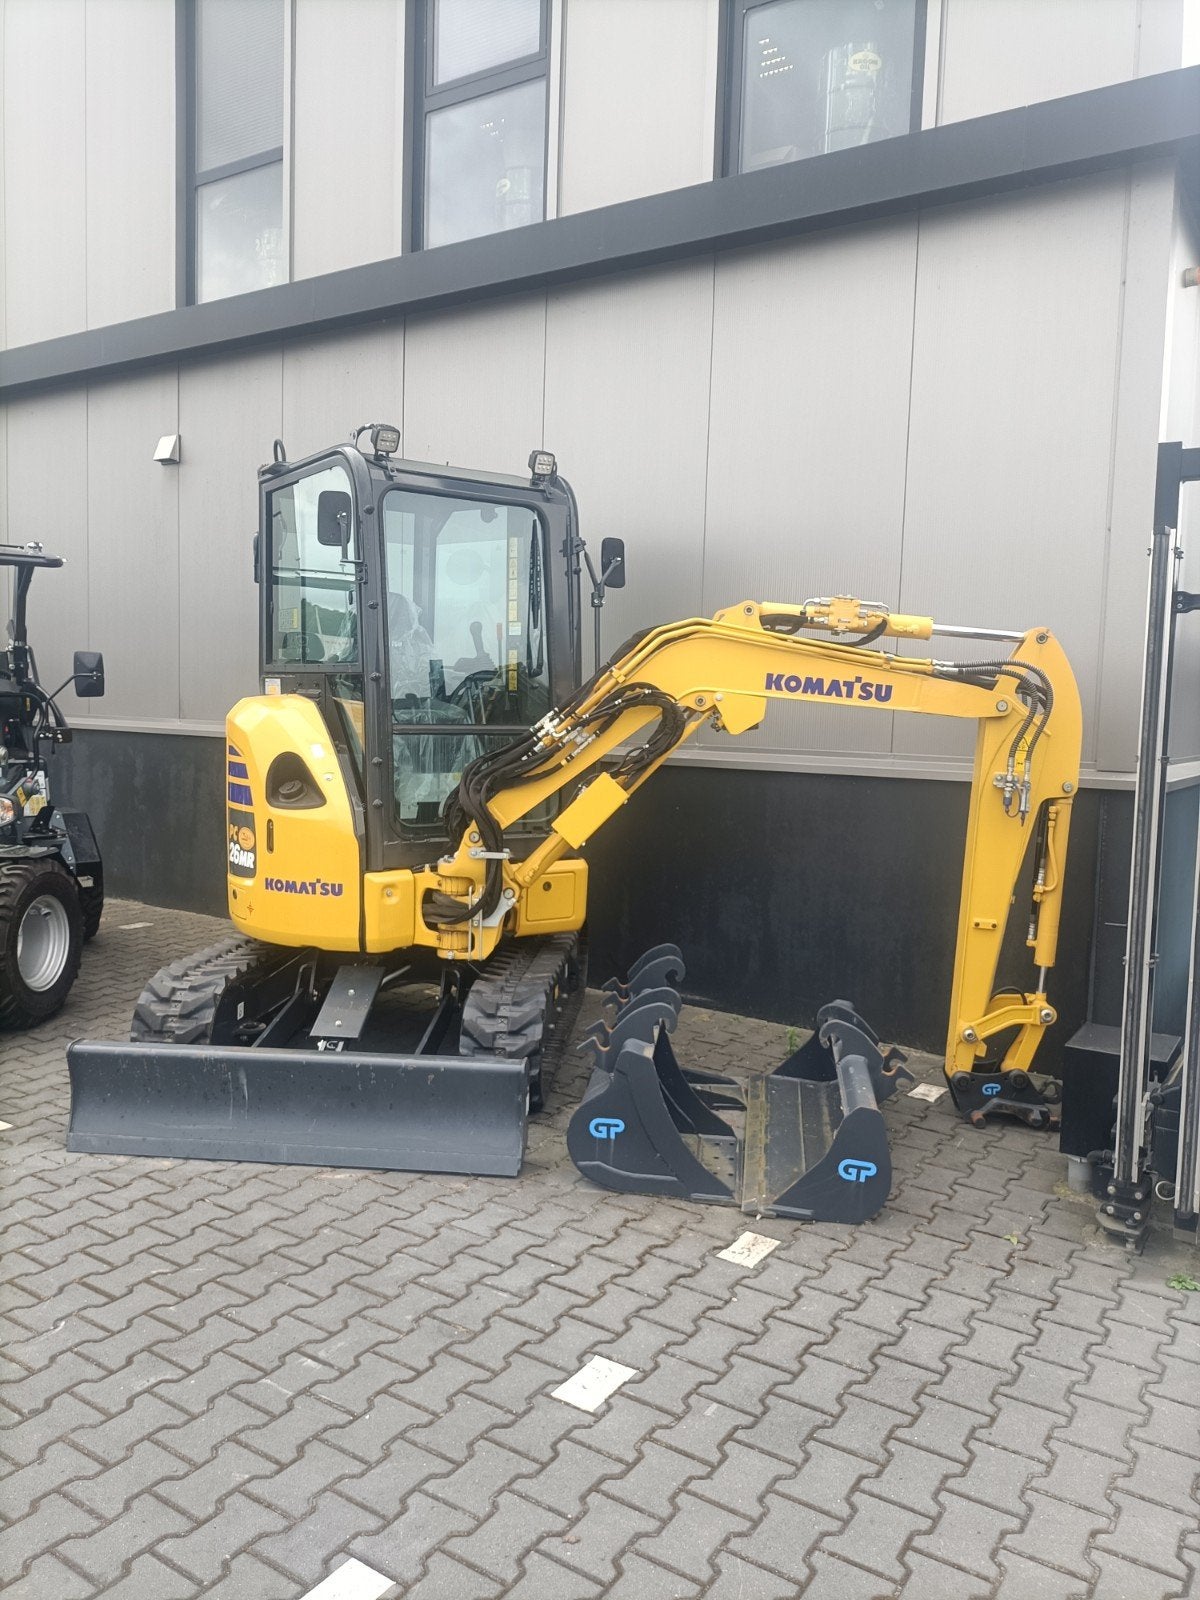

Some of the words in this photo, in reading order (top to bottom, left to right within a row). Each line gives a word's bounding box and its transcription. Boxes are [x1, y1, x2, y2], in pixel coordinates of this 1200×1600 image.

[765, 673, 893, 702] KOMATSU
[229, 842, 255, 868] 26MR
[265, 877, 343, 896] KOMATSU
[981, 1083, 1002, 1095] GP
[589, 1117, 625, 1140] GP
[838, 1158, 878, 1183] GP
